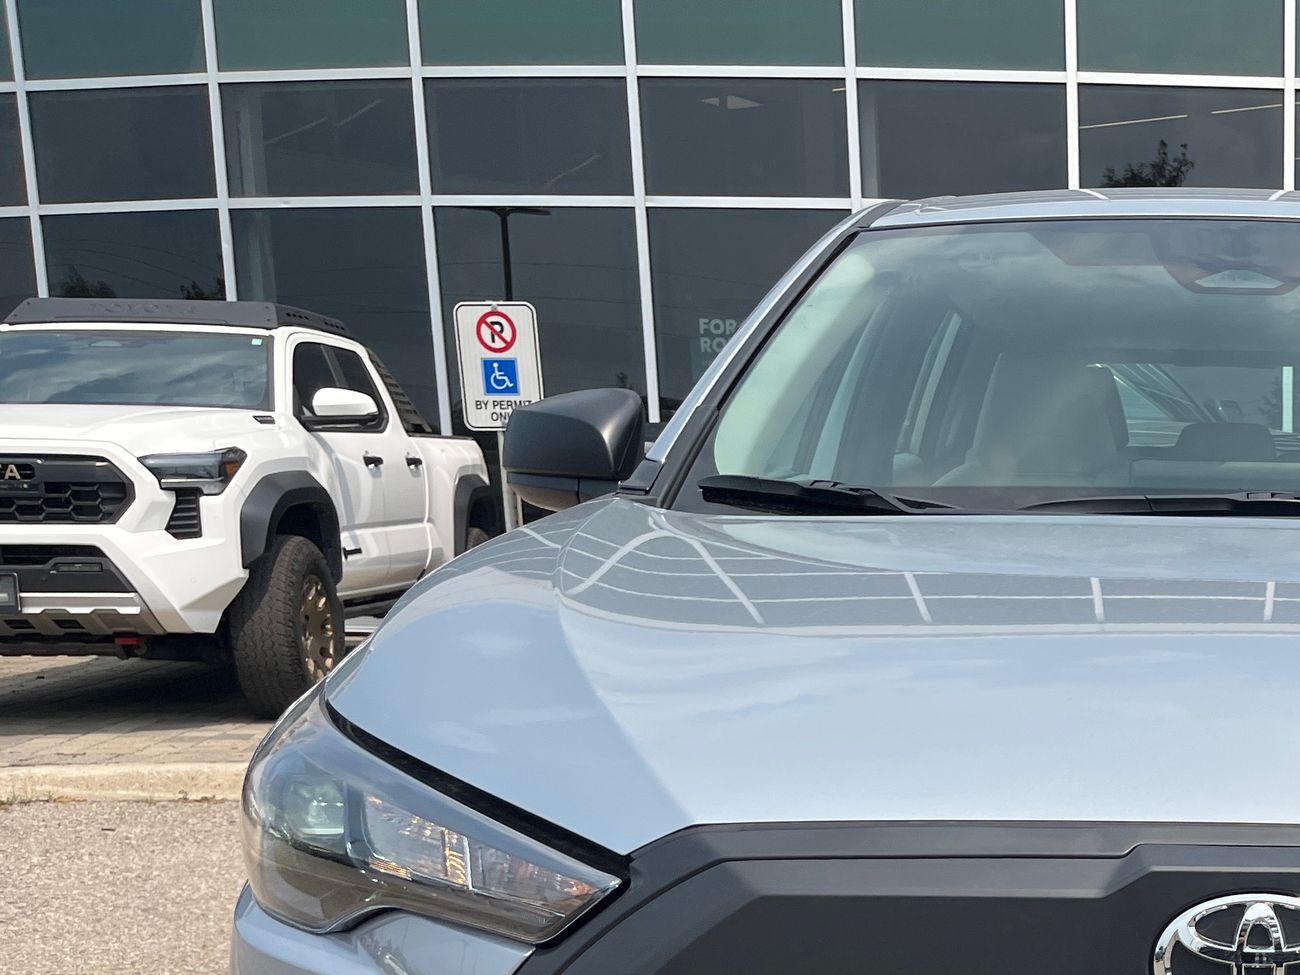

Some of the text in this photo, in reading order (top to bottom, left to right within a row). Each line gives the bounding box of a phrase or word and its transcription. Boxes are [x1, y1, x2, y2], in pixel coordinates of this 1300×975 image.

[88, 302, 198, 315] TOYOTA
[698, 318, 738, 335] FOR
[475, 400, 489, 410] BY
